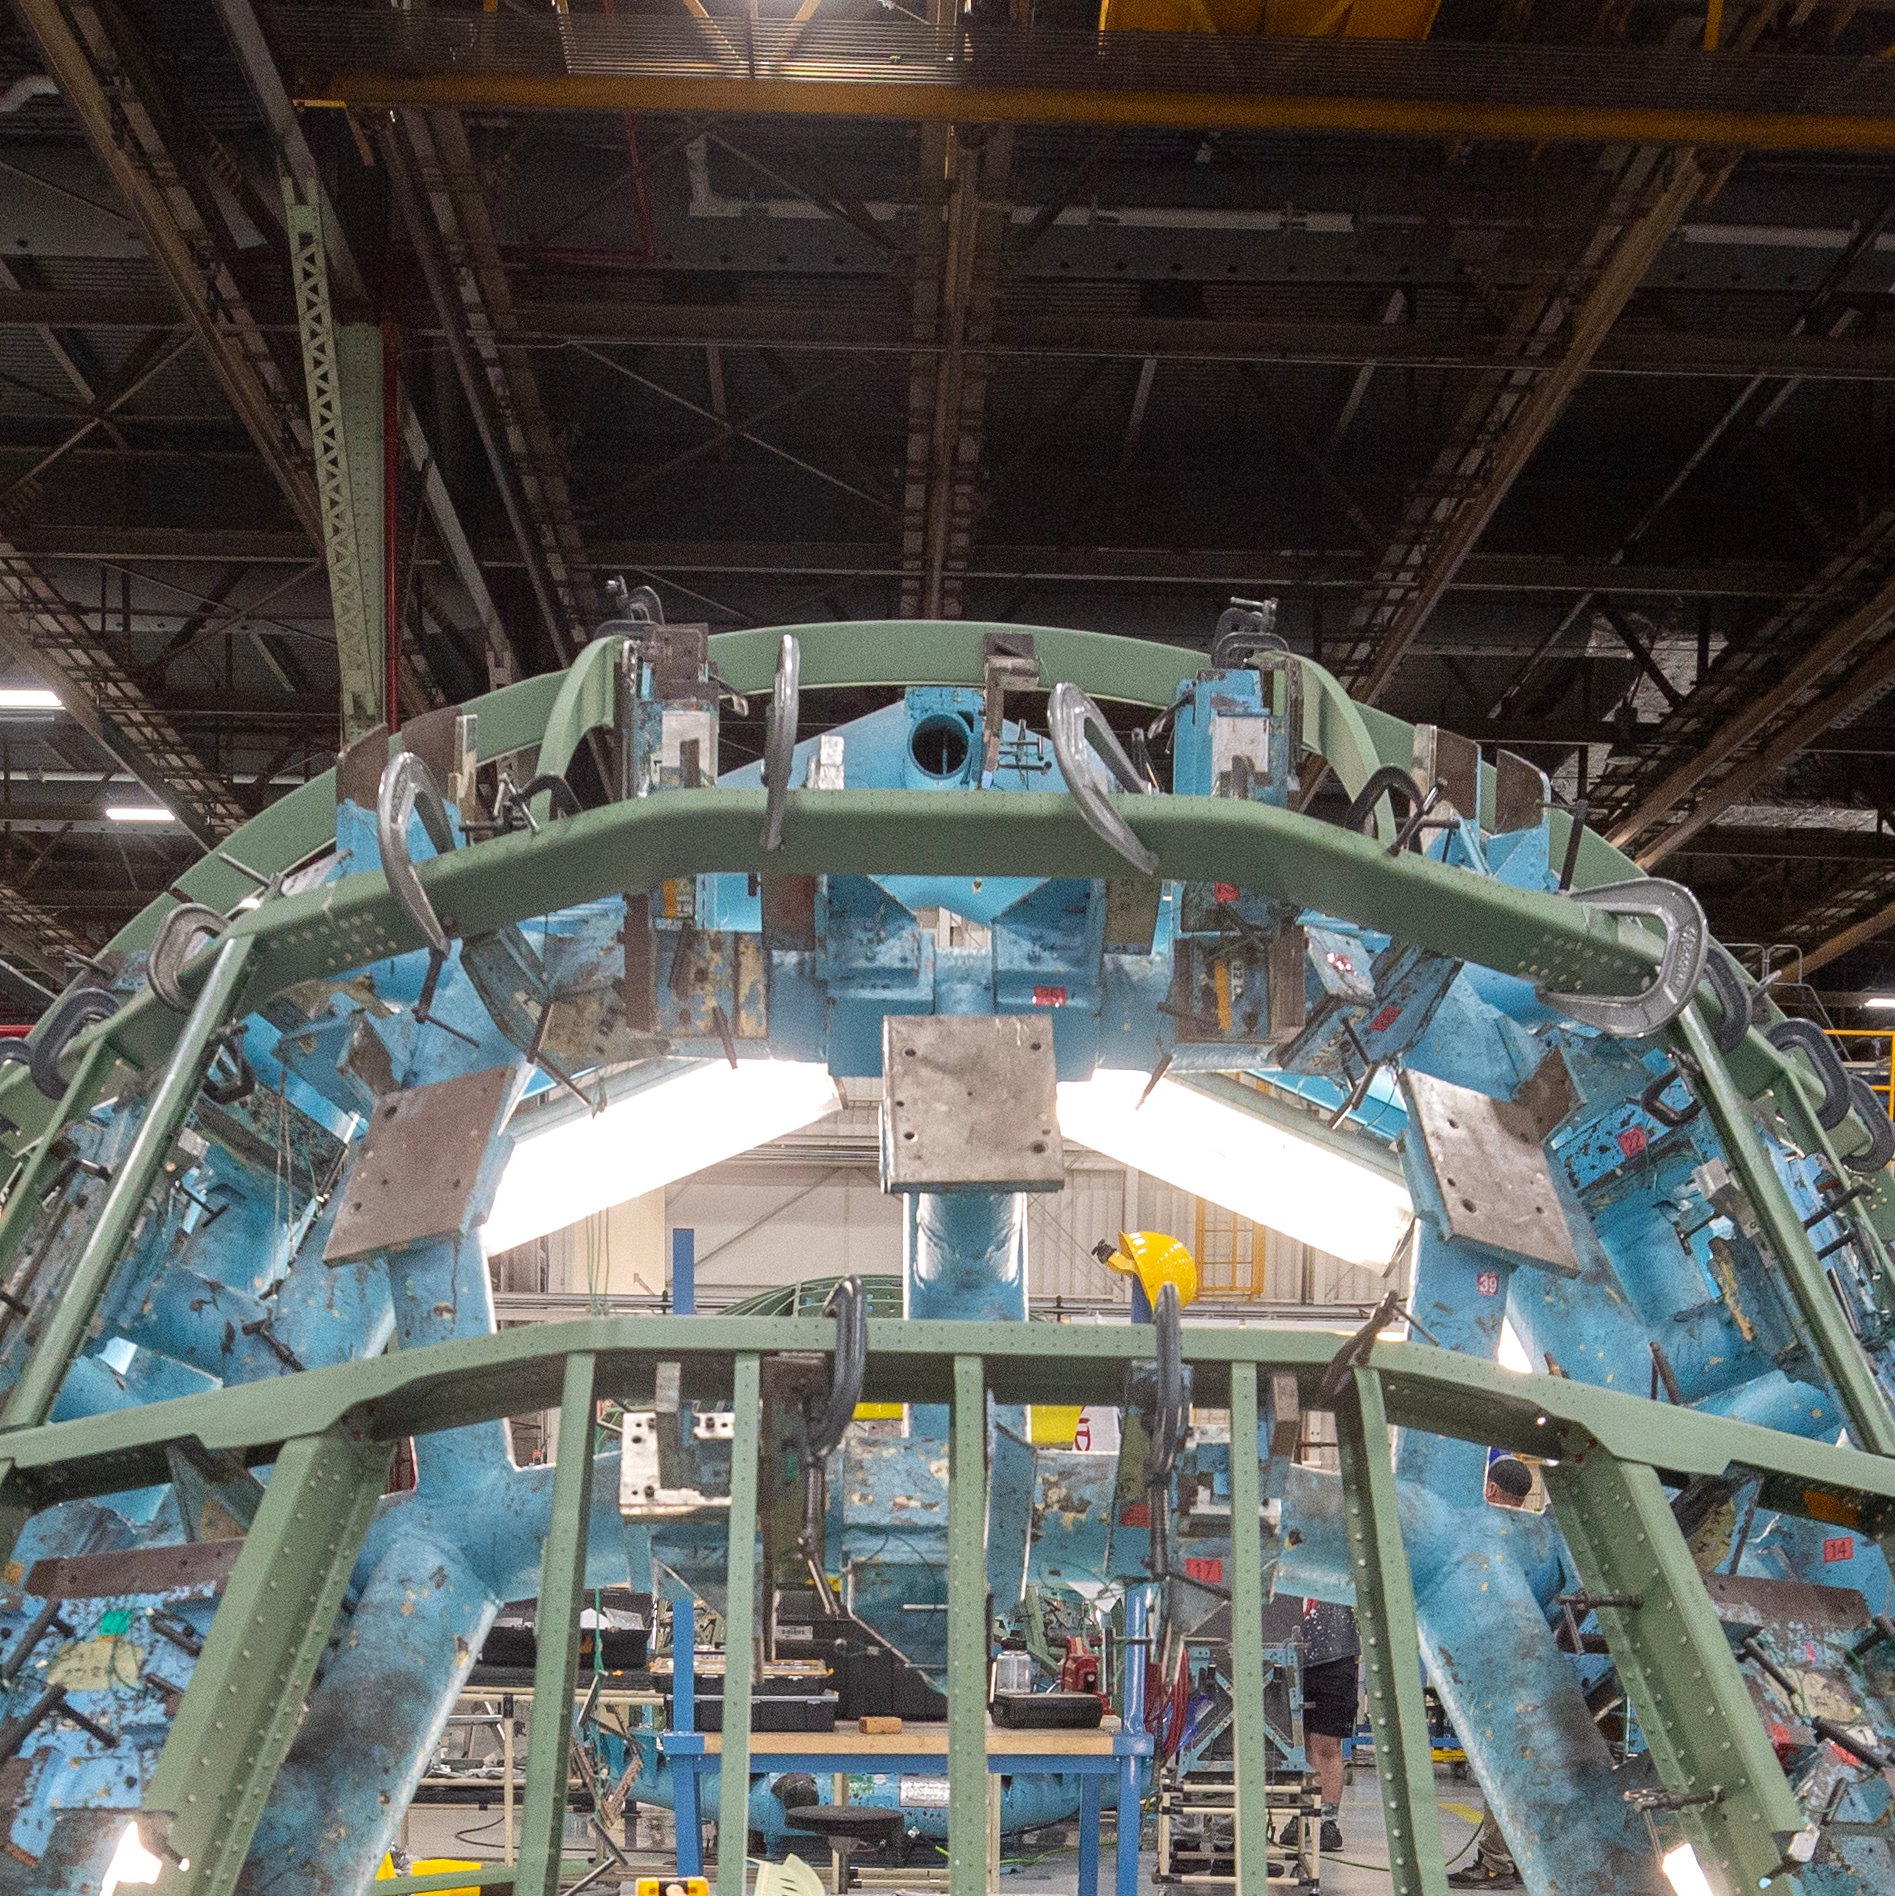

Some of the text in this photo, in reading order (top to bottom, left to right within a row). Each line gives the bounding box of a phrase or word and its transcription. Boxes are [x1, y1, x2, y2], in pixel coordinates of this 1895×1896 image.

[1478, 1273, 1497, 1294] 39
[1830, 1541, 1848, 1558] 14
[1193, 1560, 1214, 1577] 17
